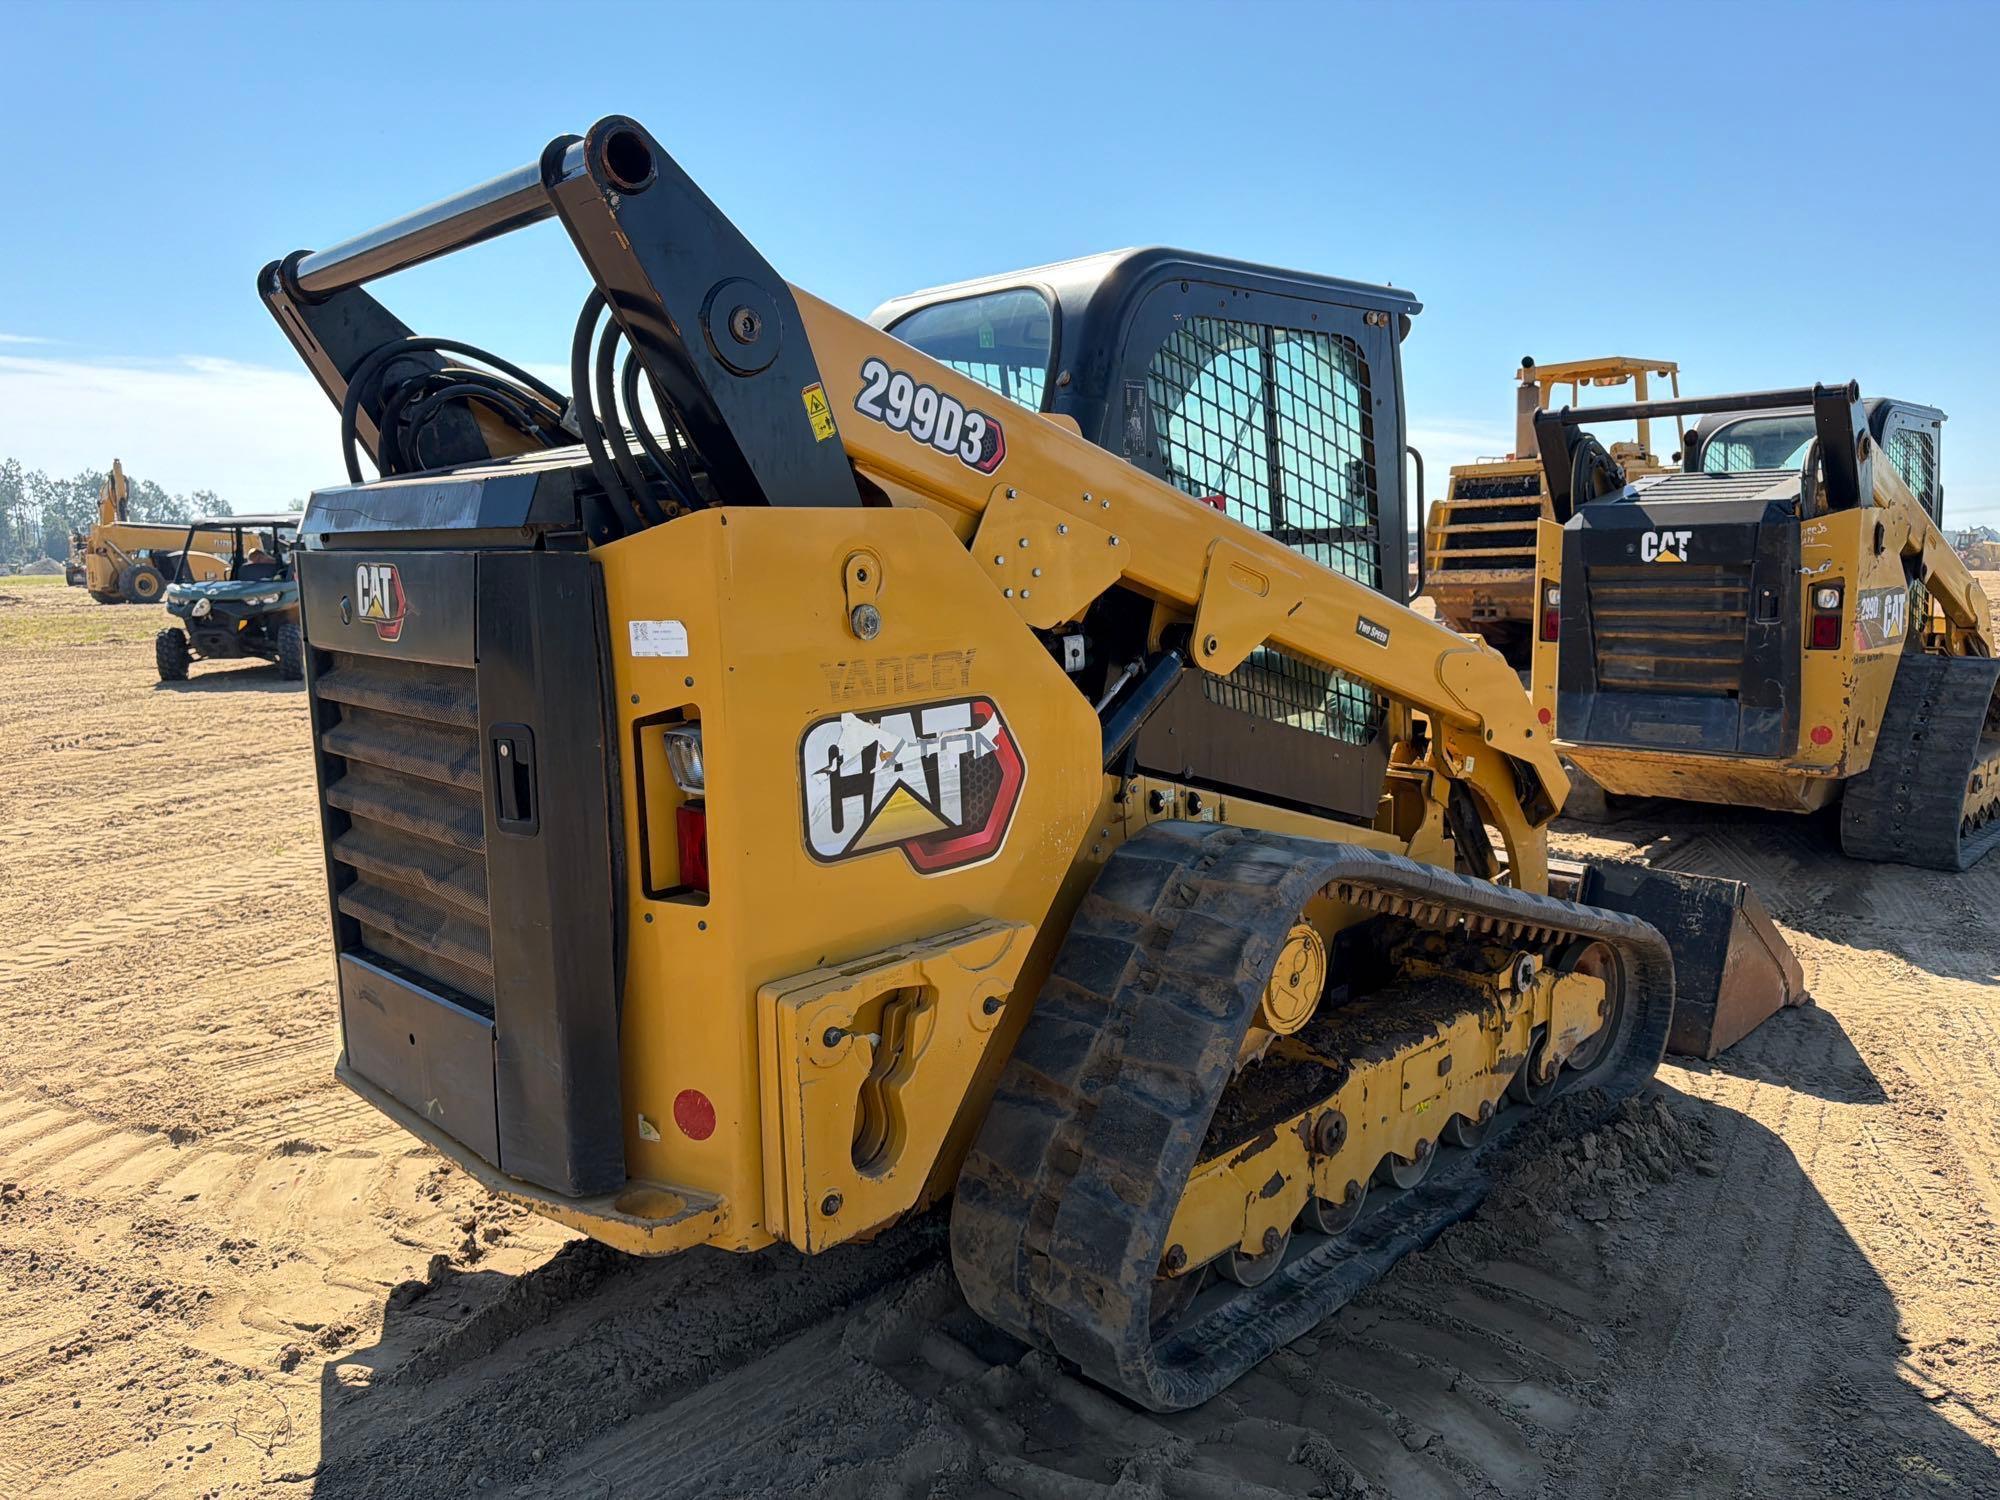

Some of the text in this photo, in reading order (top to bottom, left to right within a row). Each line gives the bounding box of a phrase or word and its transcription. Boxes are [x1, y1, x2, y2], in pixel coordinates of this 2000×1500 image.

[856, 360, 987, 464] 299D3
[1641, 531, 1693, 562] CAT
[356, 565, 392, 619] CAT
[1883, 594, 1906, 638] CAT
[803, 702, 973, 857] CAT
